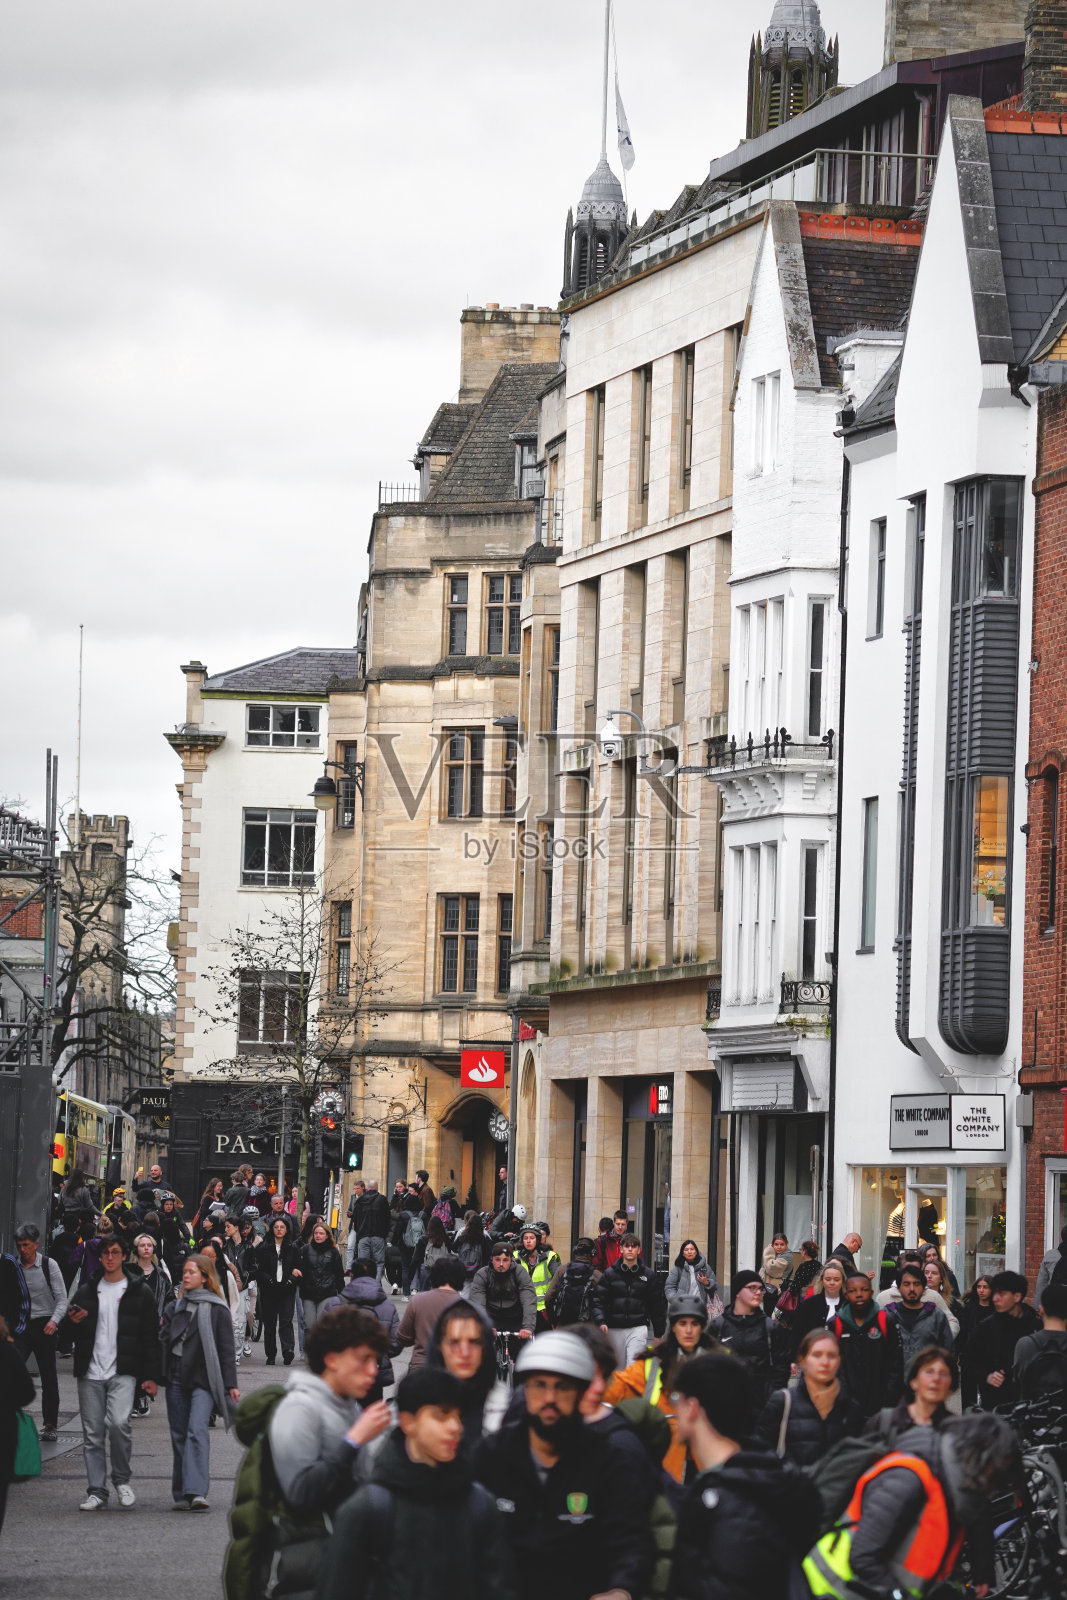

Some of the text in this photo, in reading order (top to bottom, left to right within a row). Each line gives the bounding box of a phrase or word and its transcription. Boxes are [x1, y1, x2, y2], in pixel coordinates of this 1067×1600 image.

[142, 1097, 168, 1105] PAUL
[895, 1107, 950, 1122] THE WHITE COMPANY
